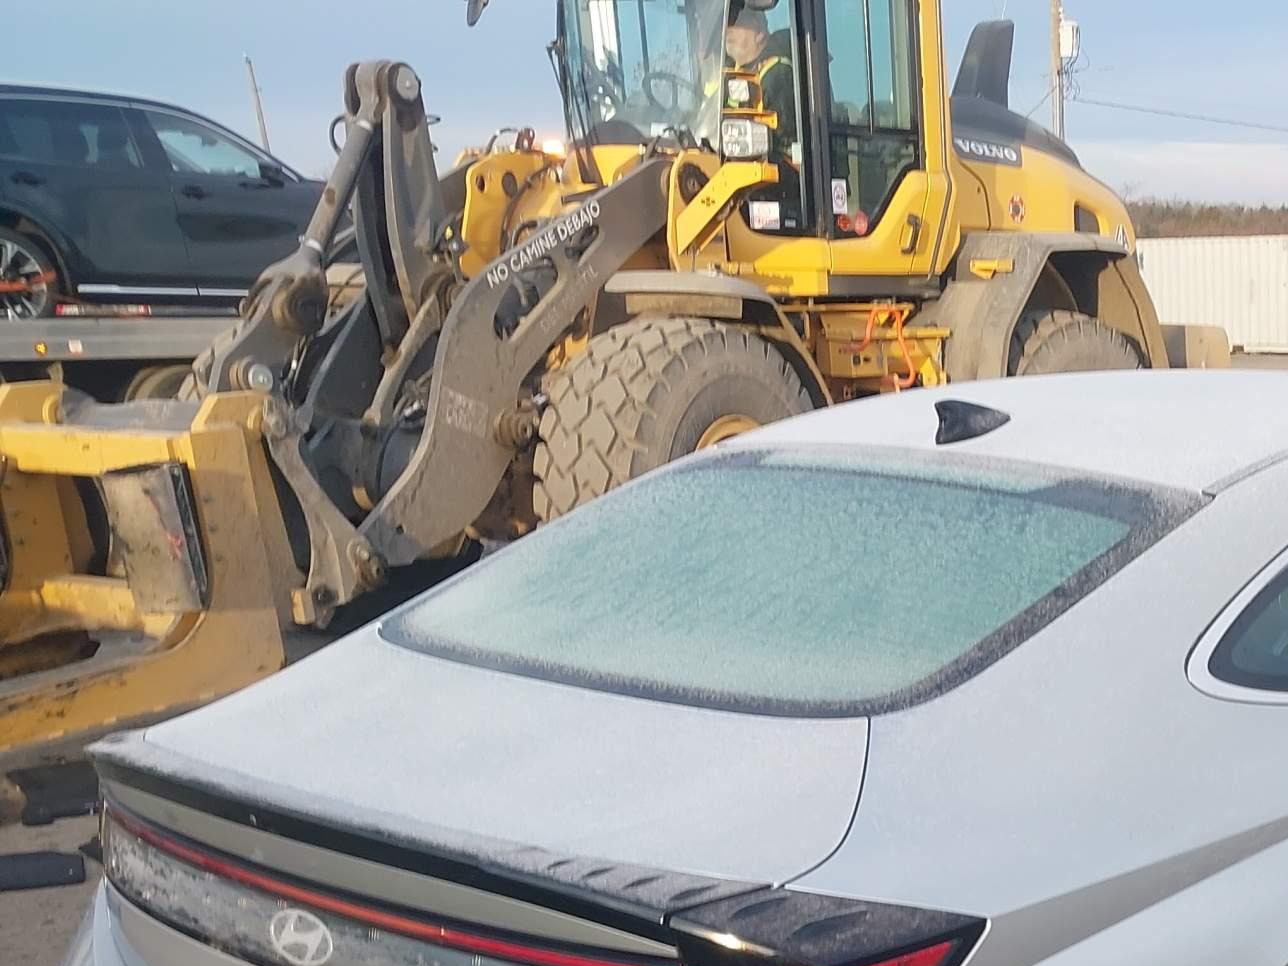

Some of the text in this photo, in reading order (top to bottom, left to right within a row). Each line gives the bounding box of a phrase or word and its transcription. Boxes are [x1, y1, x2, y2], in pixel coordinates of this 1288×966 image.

[954, 137, 1017, 161] VOLVO
[486, 200, 600, 289] NO CAMINE DEBAJO
